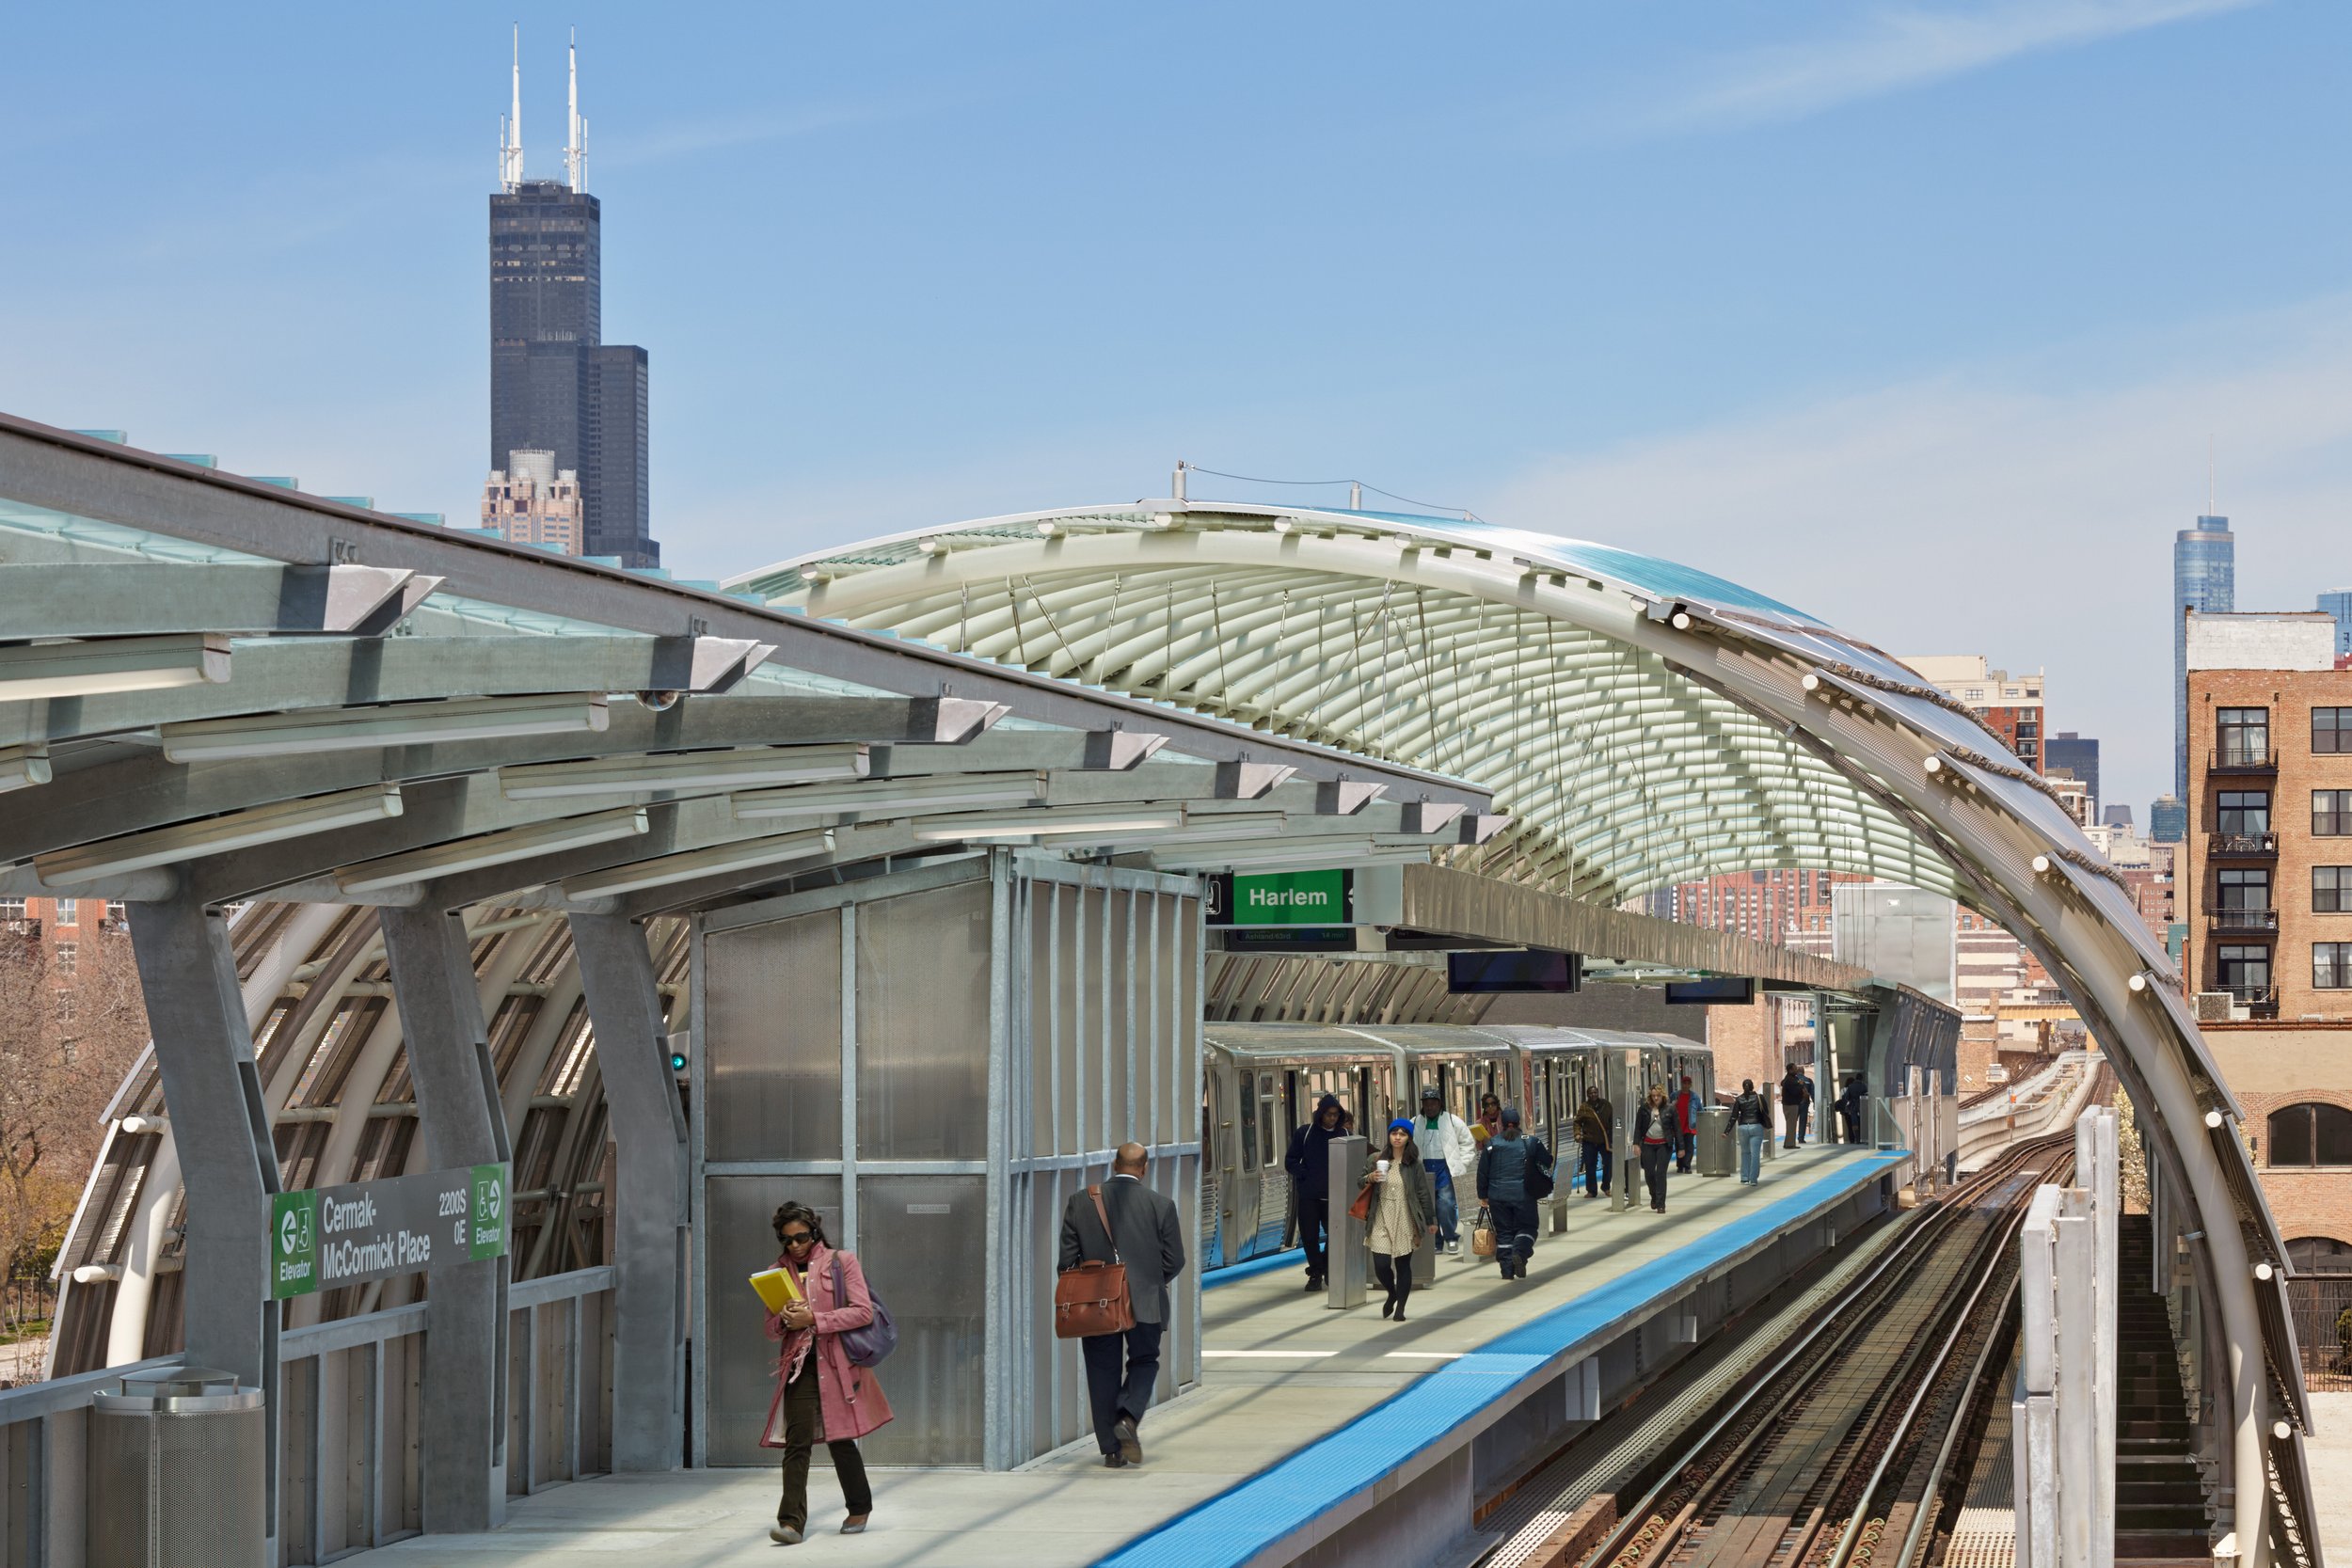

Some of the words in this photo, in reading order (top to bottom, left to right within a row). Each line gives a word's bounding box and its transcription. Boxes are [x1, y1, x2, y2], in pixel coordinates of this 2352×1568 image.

[1249, 888, 1328, 907] Harlem
[323, 1191, 377, 1234] Cermak-
[439, 1188, 467, 1217] 2200S
[453, 1219, 467, 1245] 0E
[475, 1226, 501, 1245] Elevator
[323, 1232, 395, 1280] McCormick
[397, 1229, 431, 1266] Place
[279, 1259, 311, 1282] Elevator
